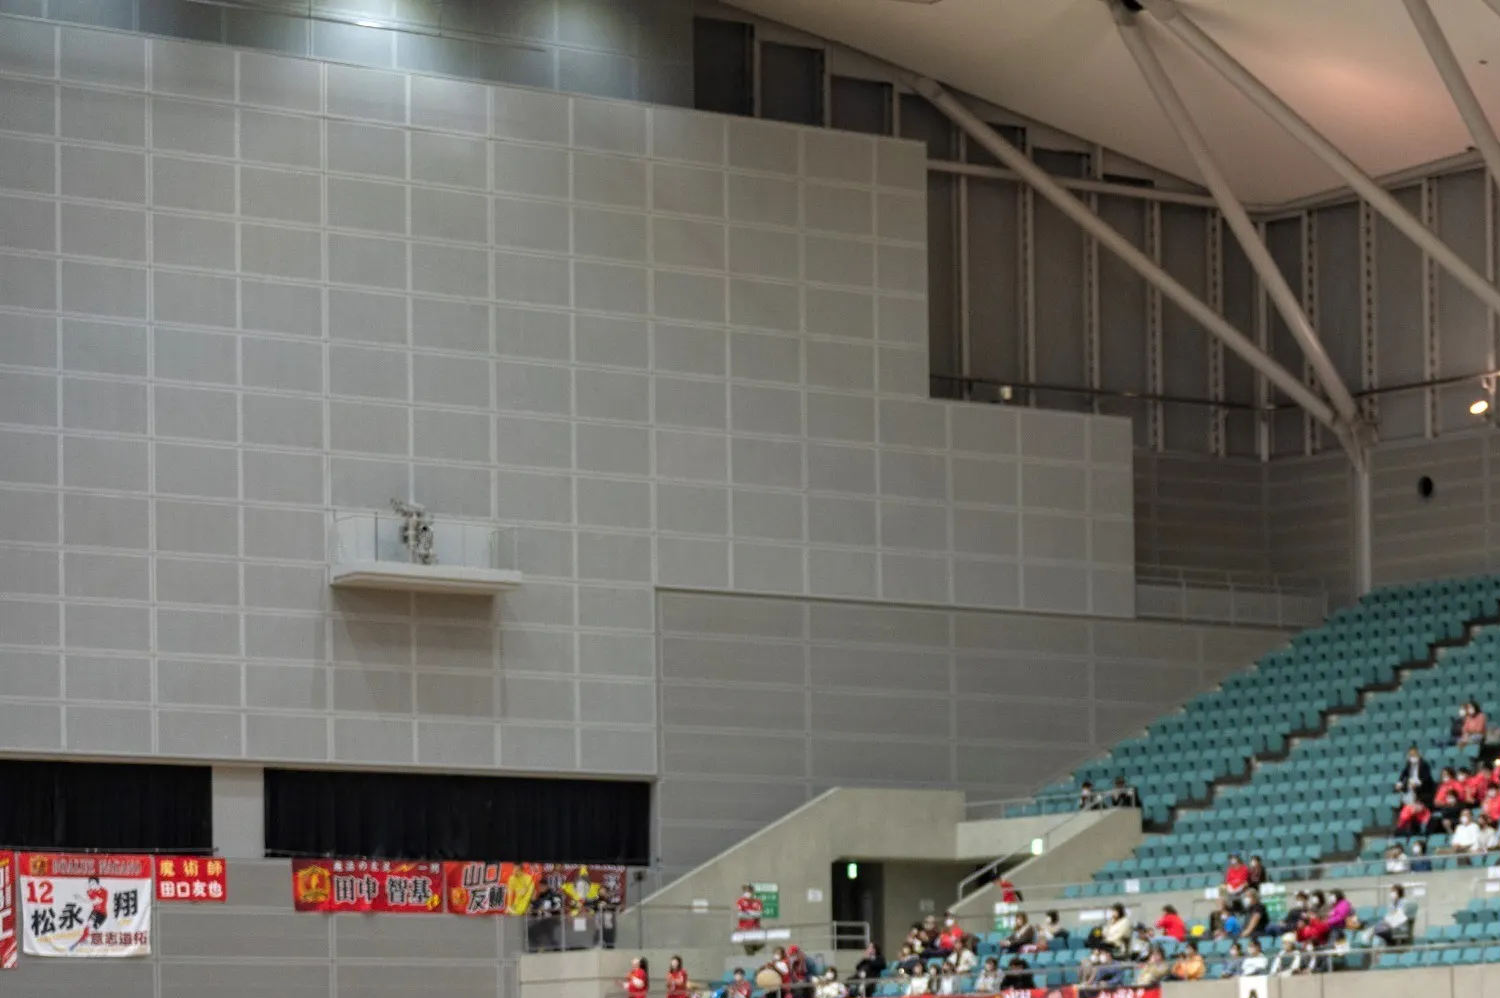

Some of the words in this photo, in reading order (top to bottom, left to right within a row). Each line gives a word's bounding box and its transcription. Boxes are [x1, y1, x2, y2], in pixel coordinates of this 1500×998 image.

[27, 881, 54, 904] 12
[334, 874, 378, 904] 田中
[31, 902, 83, 936] 松永
[113, 889, 138, 918] 翔
